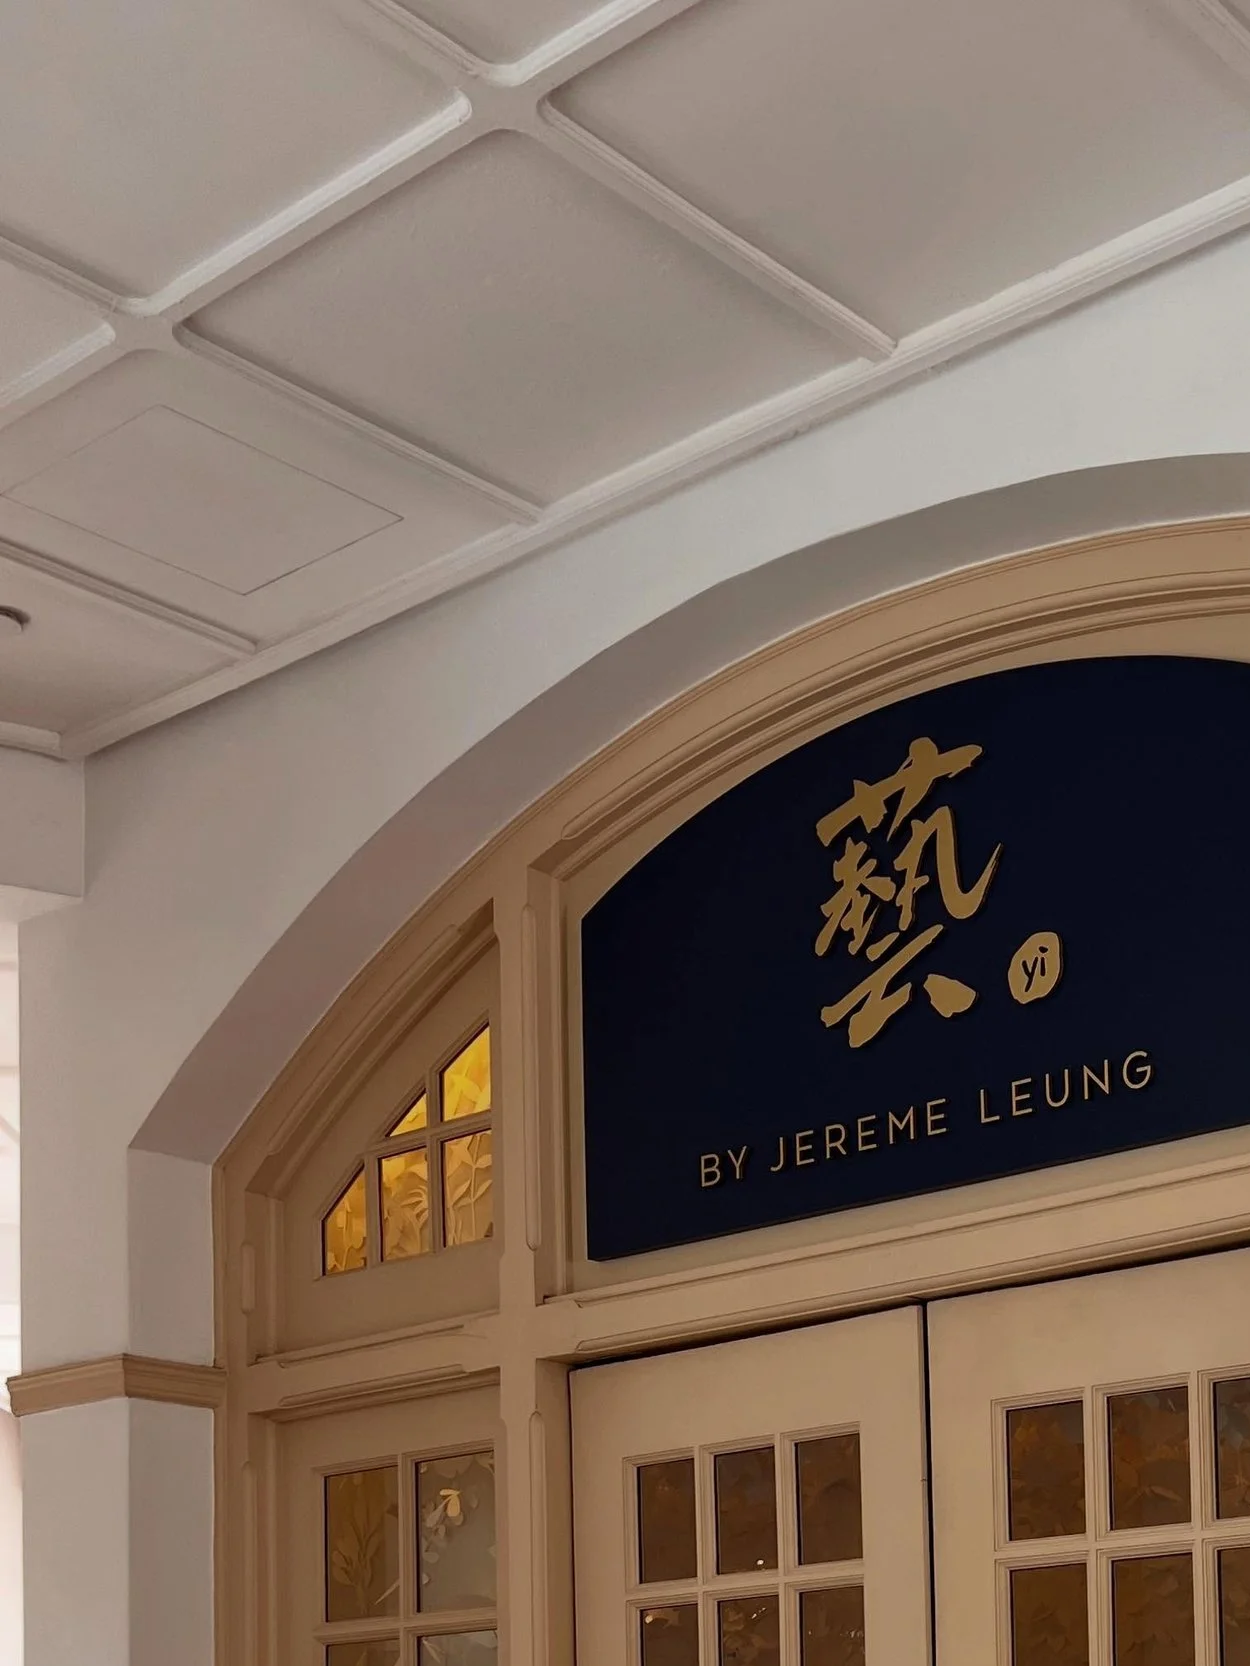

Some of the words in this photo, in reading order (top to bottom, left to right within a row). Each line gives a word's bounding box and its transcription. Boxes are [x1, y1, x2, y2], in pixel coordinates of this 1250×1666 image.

[815, 737, 1002, 1048] 藝
[699, 1146, 748, 1188] BY
[770, 1098, 948, 1173] JEREME
[979, 1050, 1152, 1125] LEUNG
